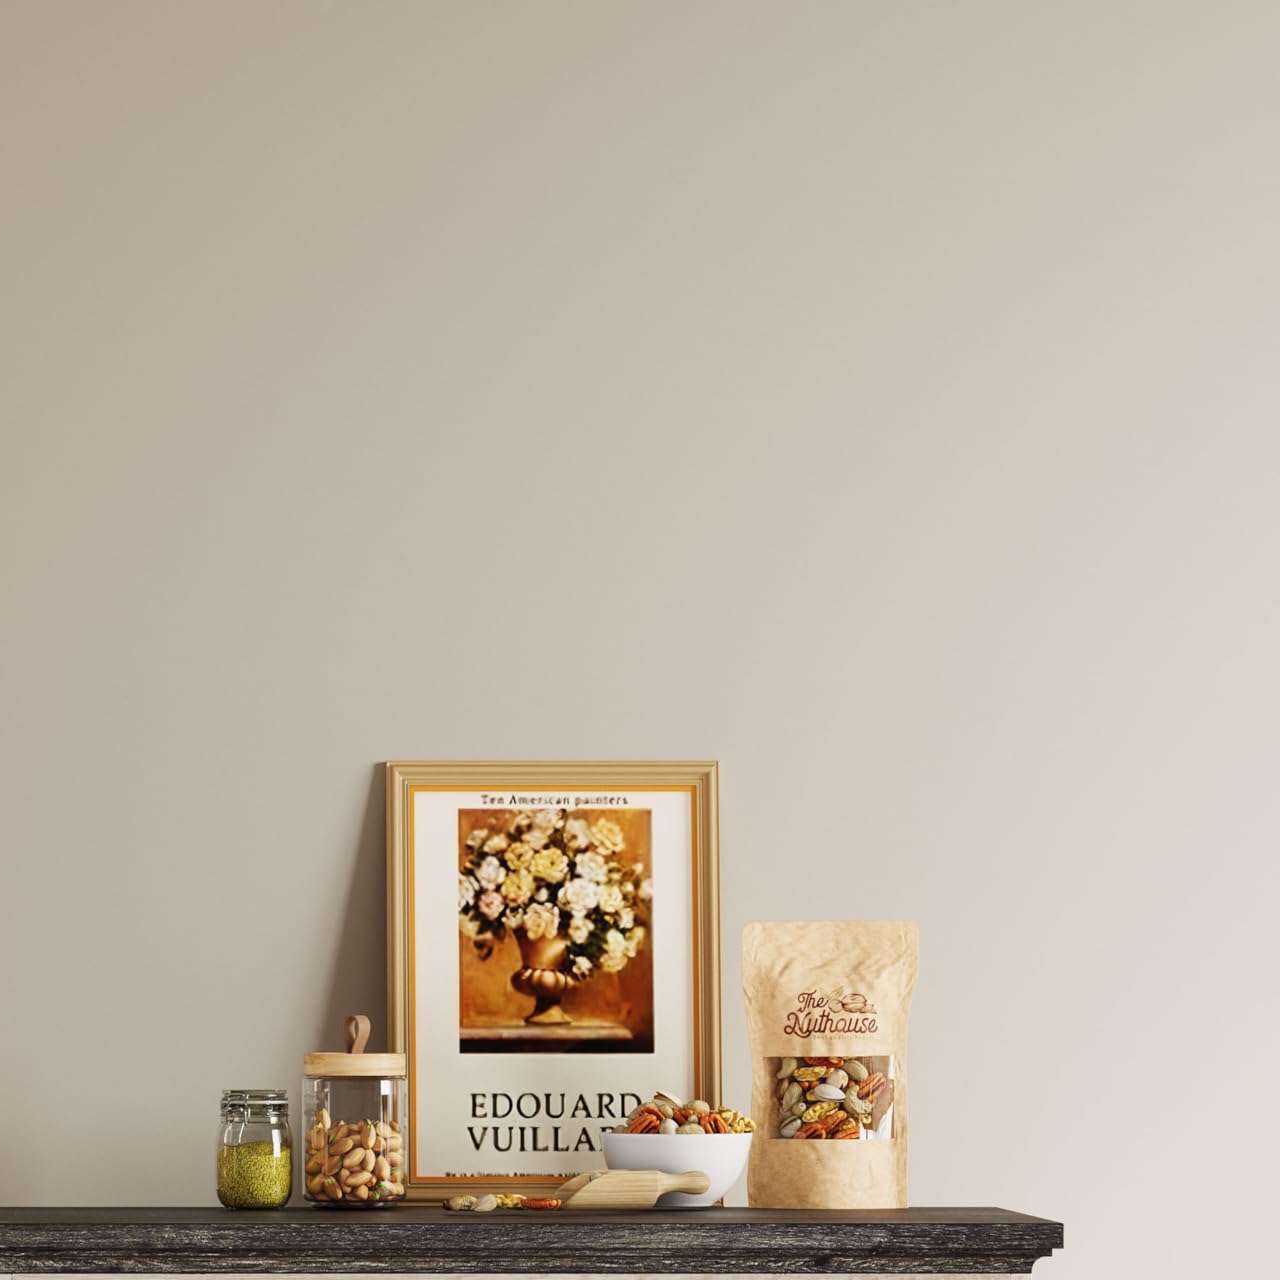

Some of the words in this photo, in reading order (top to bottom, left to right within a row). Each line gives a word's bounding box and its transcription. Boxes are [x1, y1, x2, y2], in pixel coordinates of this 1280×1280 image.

[480, 794, 505, 805] Ten
[509, 794, 570, 805] American
[575, 795, 629, 807] painters
[797, 989, 829, 1013] The
[470, 1092, 642, 1119] EDOUARD
